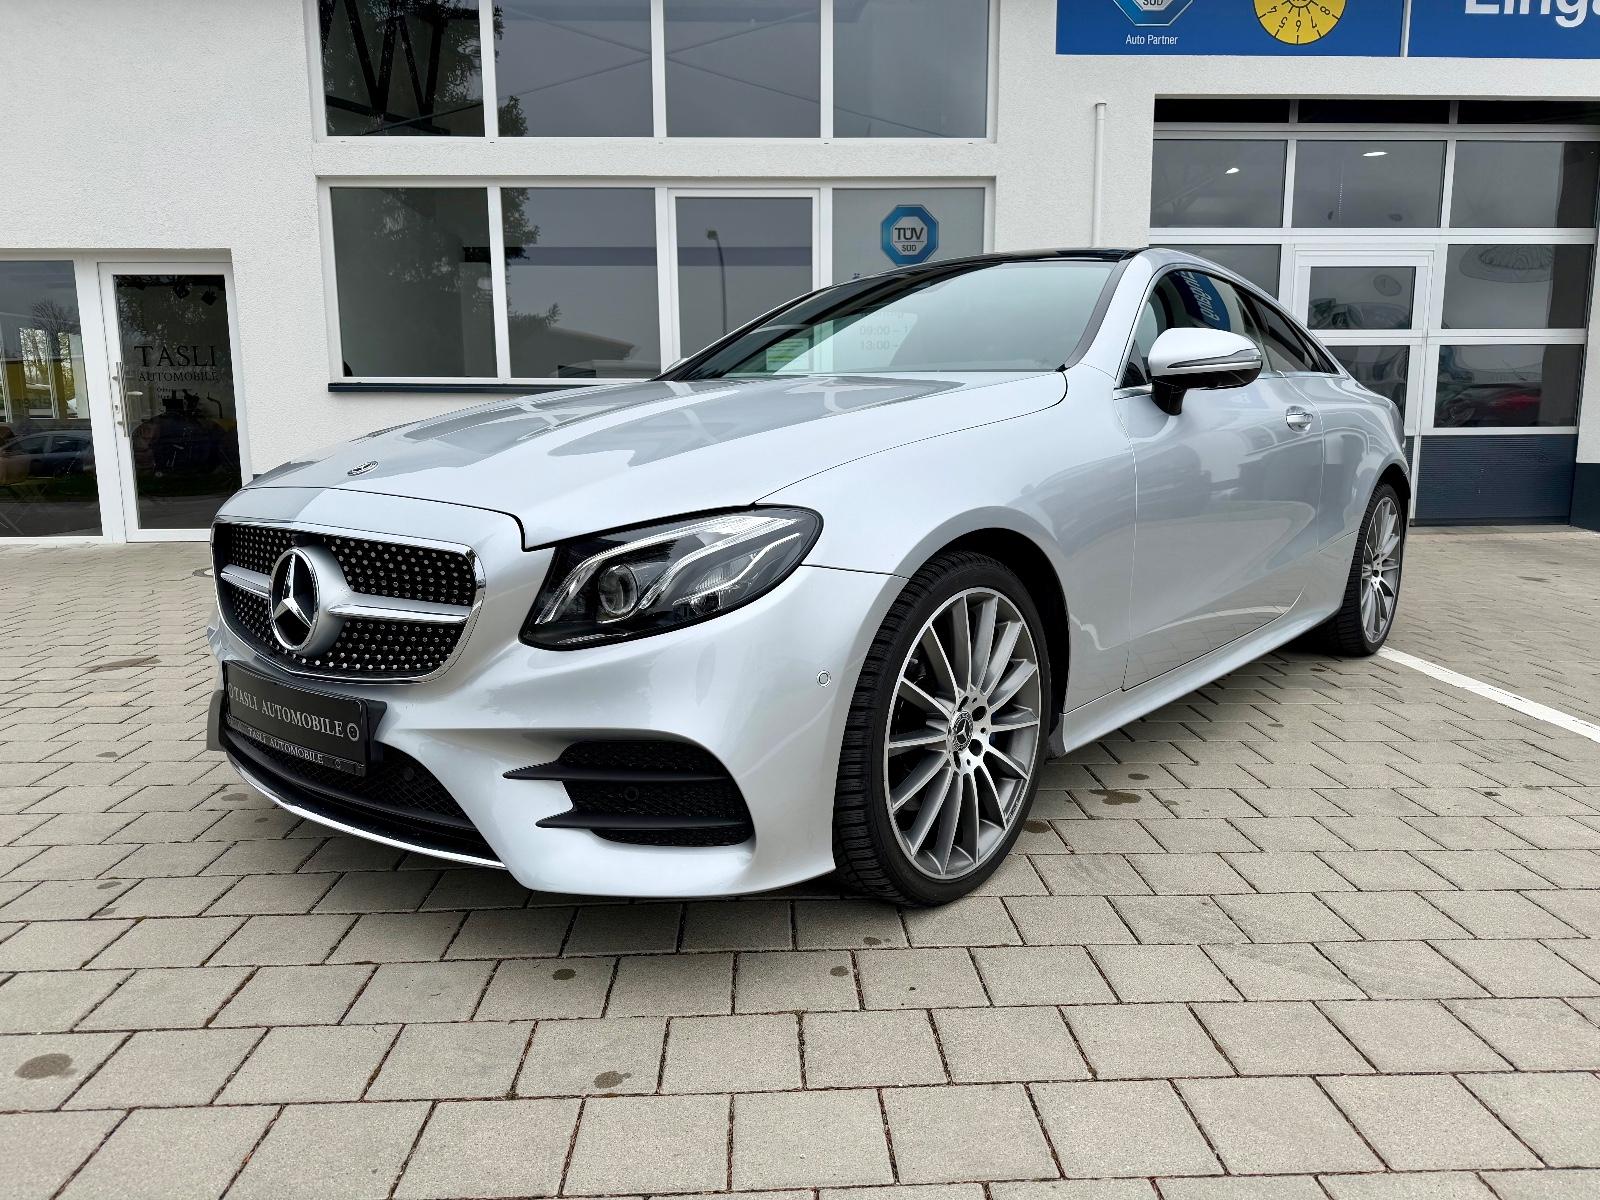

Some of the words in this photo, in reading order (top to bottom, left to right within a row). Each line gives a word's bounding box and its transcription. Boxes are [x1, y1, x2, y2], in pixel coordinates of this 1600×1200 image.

[1125, 34, 1145, 45] Auto
[1147, 34, 1178, 45] Partner
[894, 227, 924, 241] TÜV
[901, 244, 917, 252] SÜD
[133, 345, 217, 368] TASLI
[232, 686, 259, 711] TASLI
[261, 699, 345, 738] AUTOMOBILE
[247, 727, 268, 744] TASLI
[269, 738, 324, 766] AUTOMOBILE
